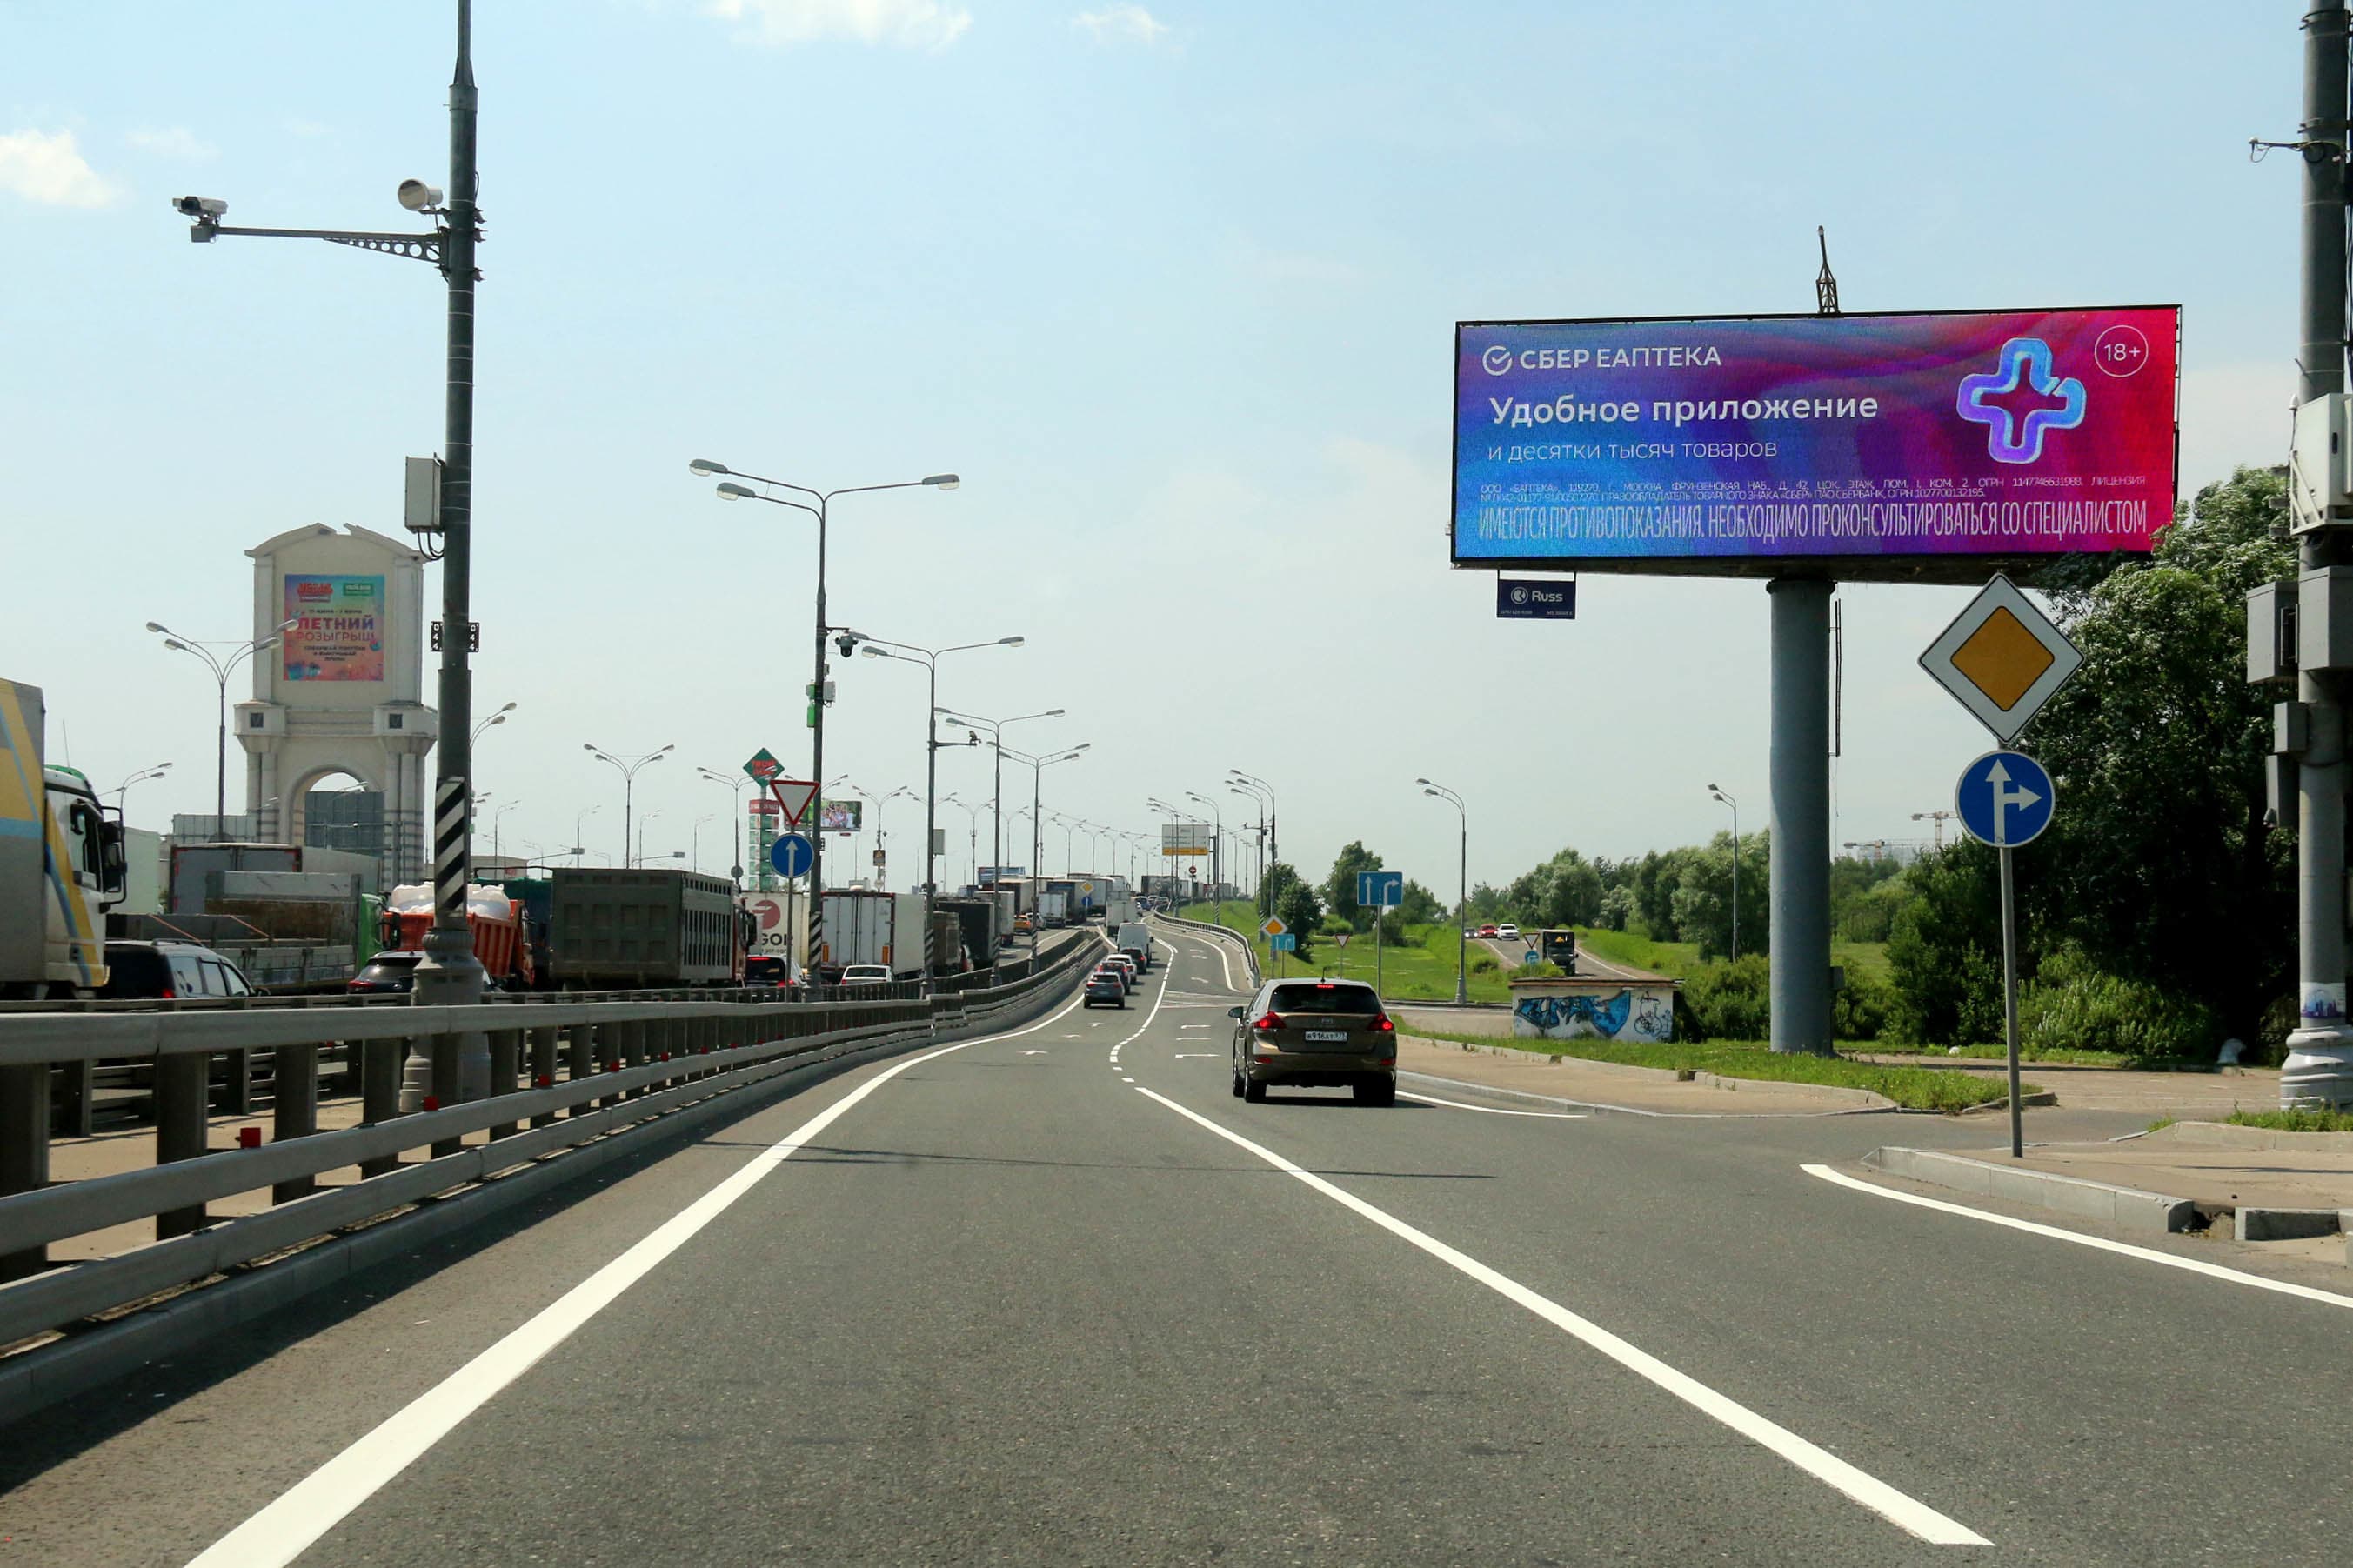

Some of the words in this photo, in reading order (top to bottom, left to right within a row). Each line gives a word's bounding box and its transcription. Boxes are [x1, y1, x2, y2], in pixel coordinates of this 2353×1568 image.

[1520, 349, 1590, 370] СБЕР
[1596, 346, 1722, 368] ЕАПТЕКА
[2103, 344, 2141, 361] 18+
[1489, 394, 1641, 428] Удобное
[1652, 397, 1879, 427] приложение
[1488, 446, 1501, 461] и
[1508, 444, 1601, 463] десятки
[1608, 443, 1675, 459] тысяч
[1682, 442, 1777, 462] товаров
[1480, 506, 1547, 539] ИМЕЮТСЯ
[1549, 504, 1705, 539] ПРОТИВОПОКАЗАНИЯ.
[1708, 504, 1809, 544] НЕОБХОДИМО
[1811, 502, 1998, 537] ПРОКОНСУЛЬТИРОВАТЬСЯ
[2002, 501, 2021, 536] СО
[2023, 500, 2148, 542] СПЕЦИАЛИСТОМ
[1531, 591, 1563, 603] Russ
[297, 614, 375, 630] ЛЕТНИЙ
